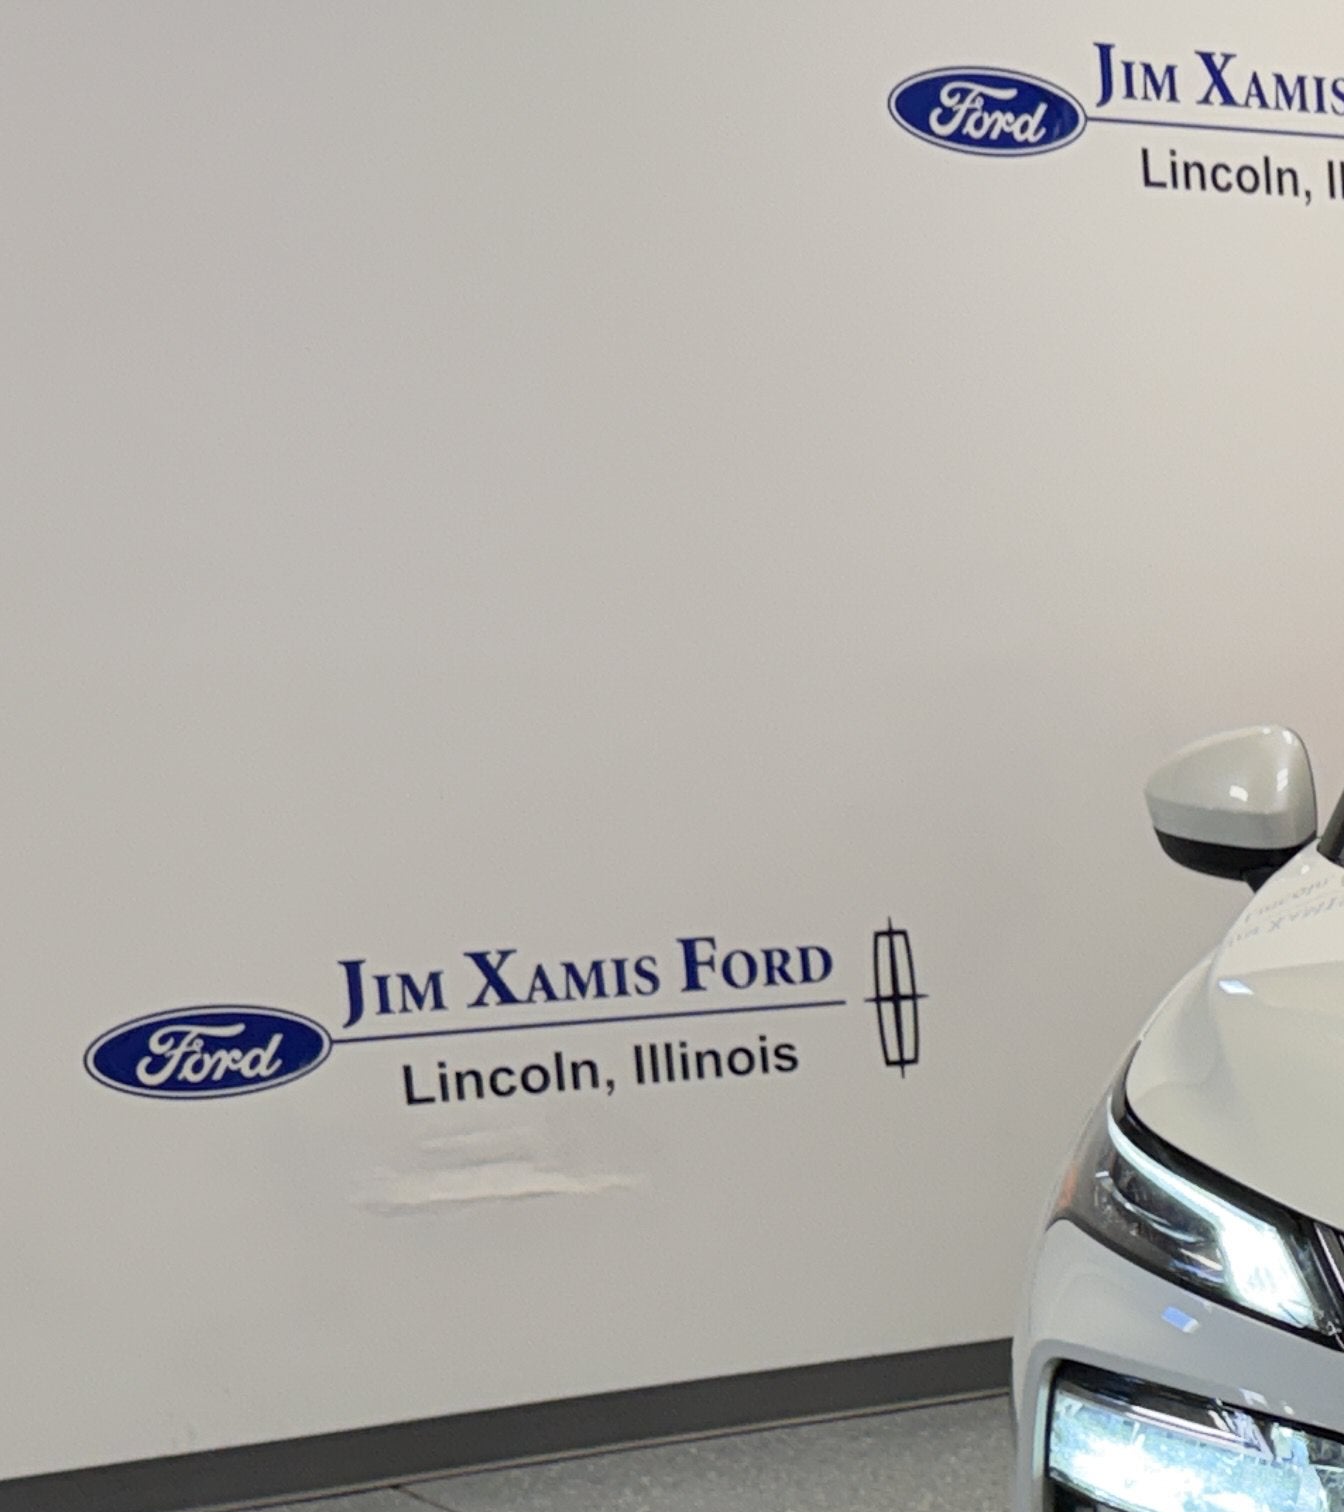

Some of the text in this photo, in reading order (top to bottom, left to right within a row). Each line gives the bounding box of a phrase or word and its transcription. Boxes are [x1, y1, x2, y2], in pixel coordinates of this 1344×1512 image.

[929, 80, 1047, 144] Ford
[1141, 148, 1313, 203] Lincoln,
[136, 1022, 283, 1084] Ford
[402, 1035, 799, 1107] Lincoln, Illinois
